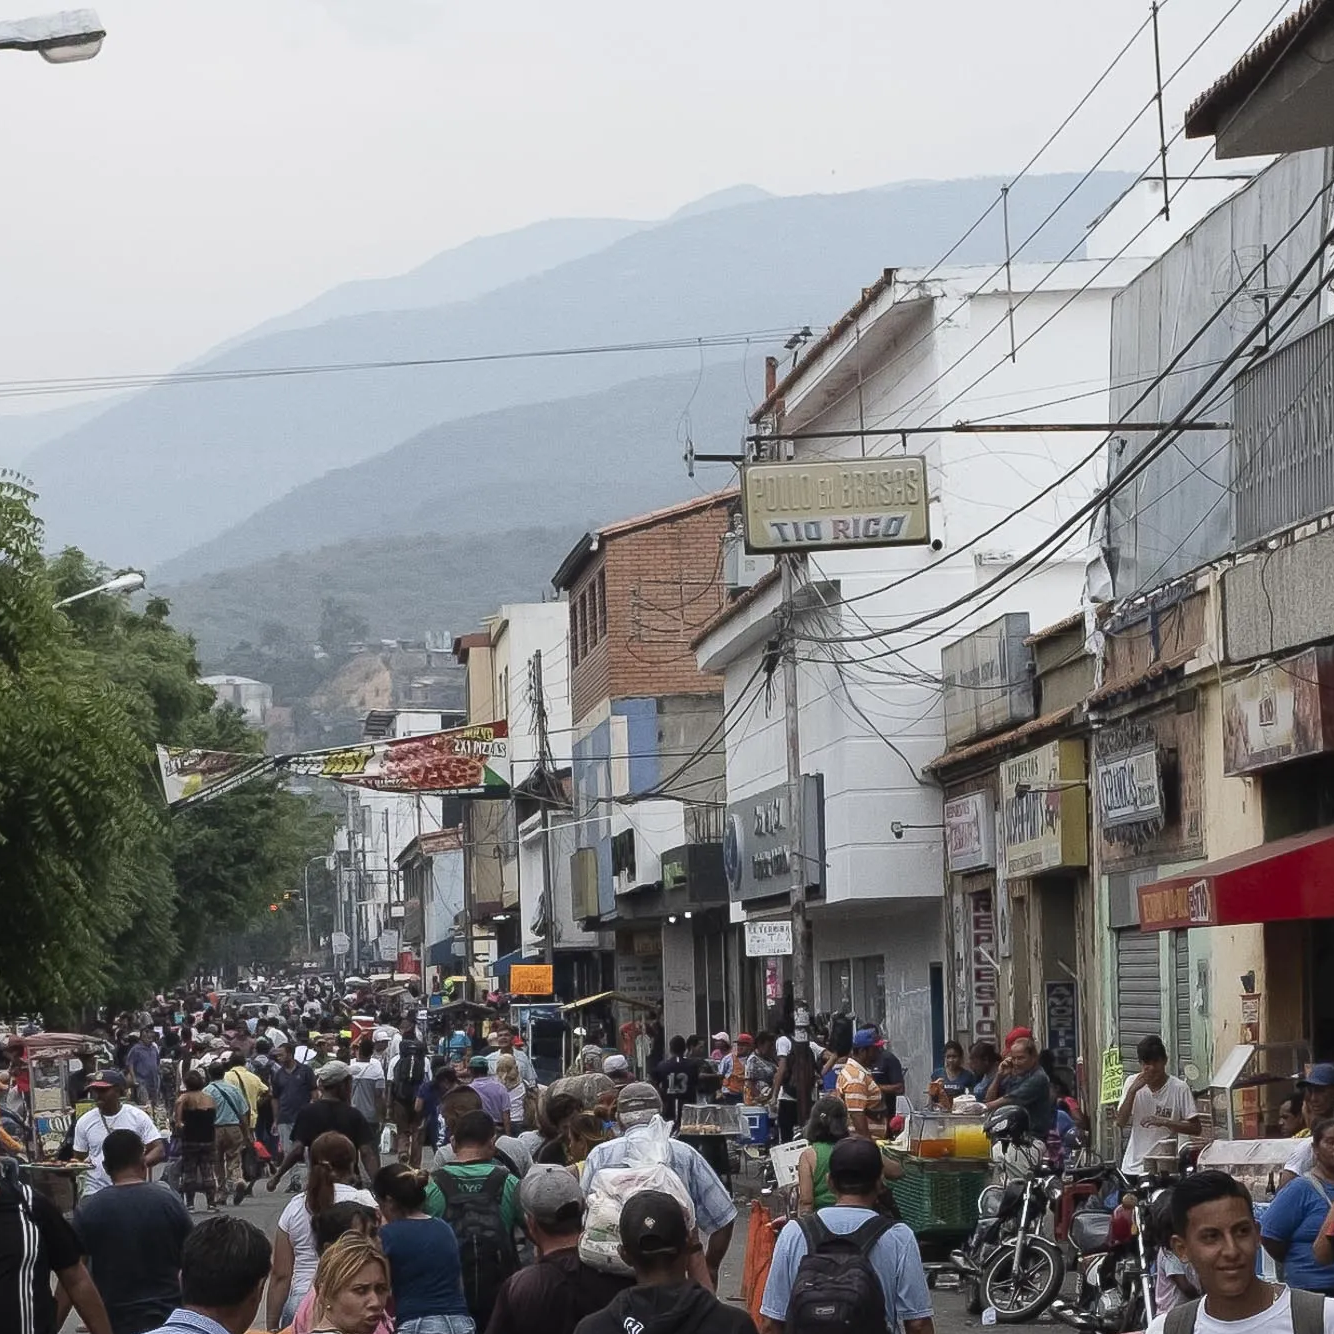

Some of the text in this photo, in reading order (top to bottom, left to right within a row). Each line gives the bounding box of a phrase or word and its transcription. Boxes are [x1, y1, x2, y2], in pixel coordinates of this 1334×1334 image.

[839, 467, 918, 509] BRASAS
[770, 514, 907, 543] TIO RICO
[667, 1072, 689, 1095] 13
